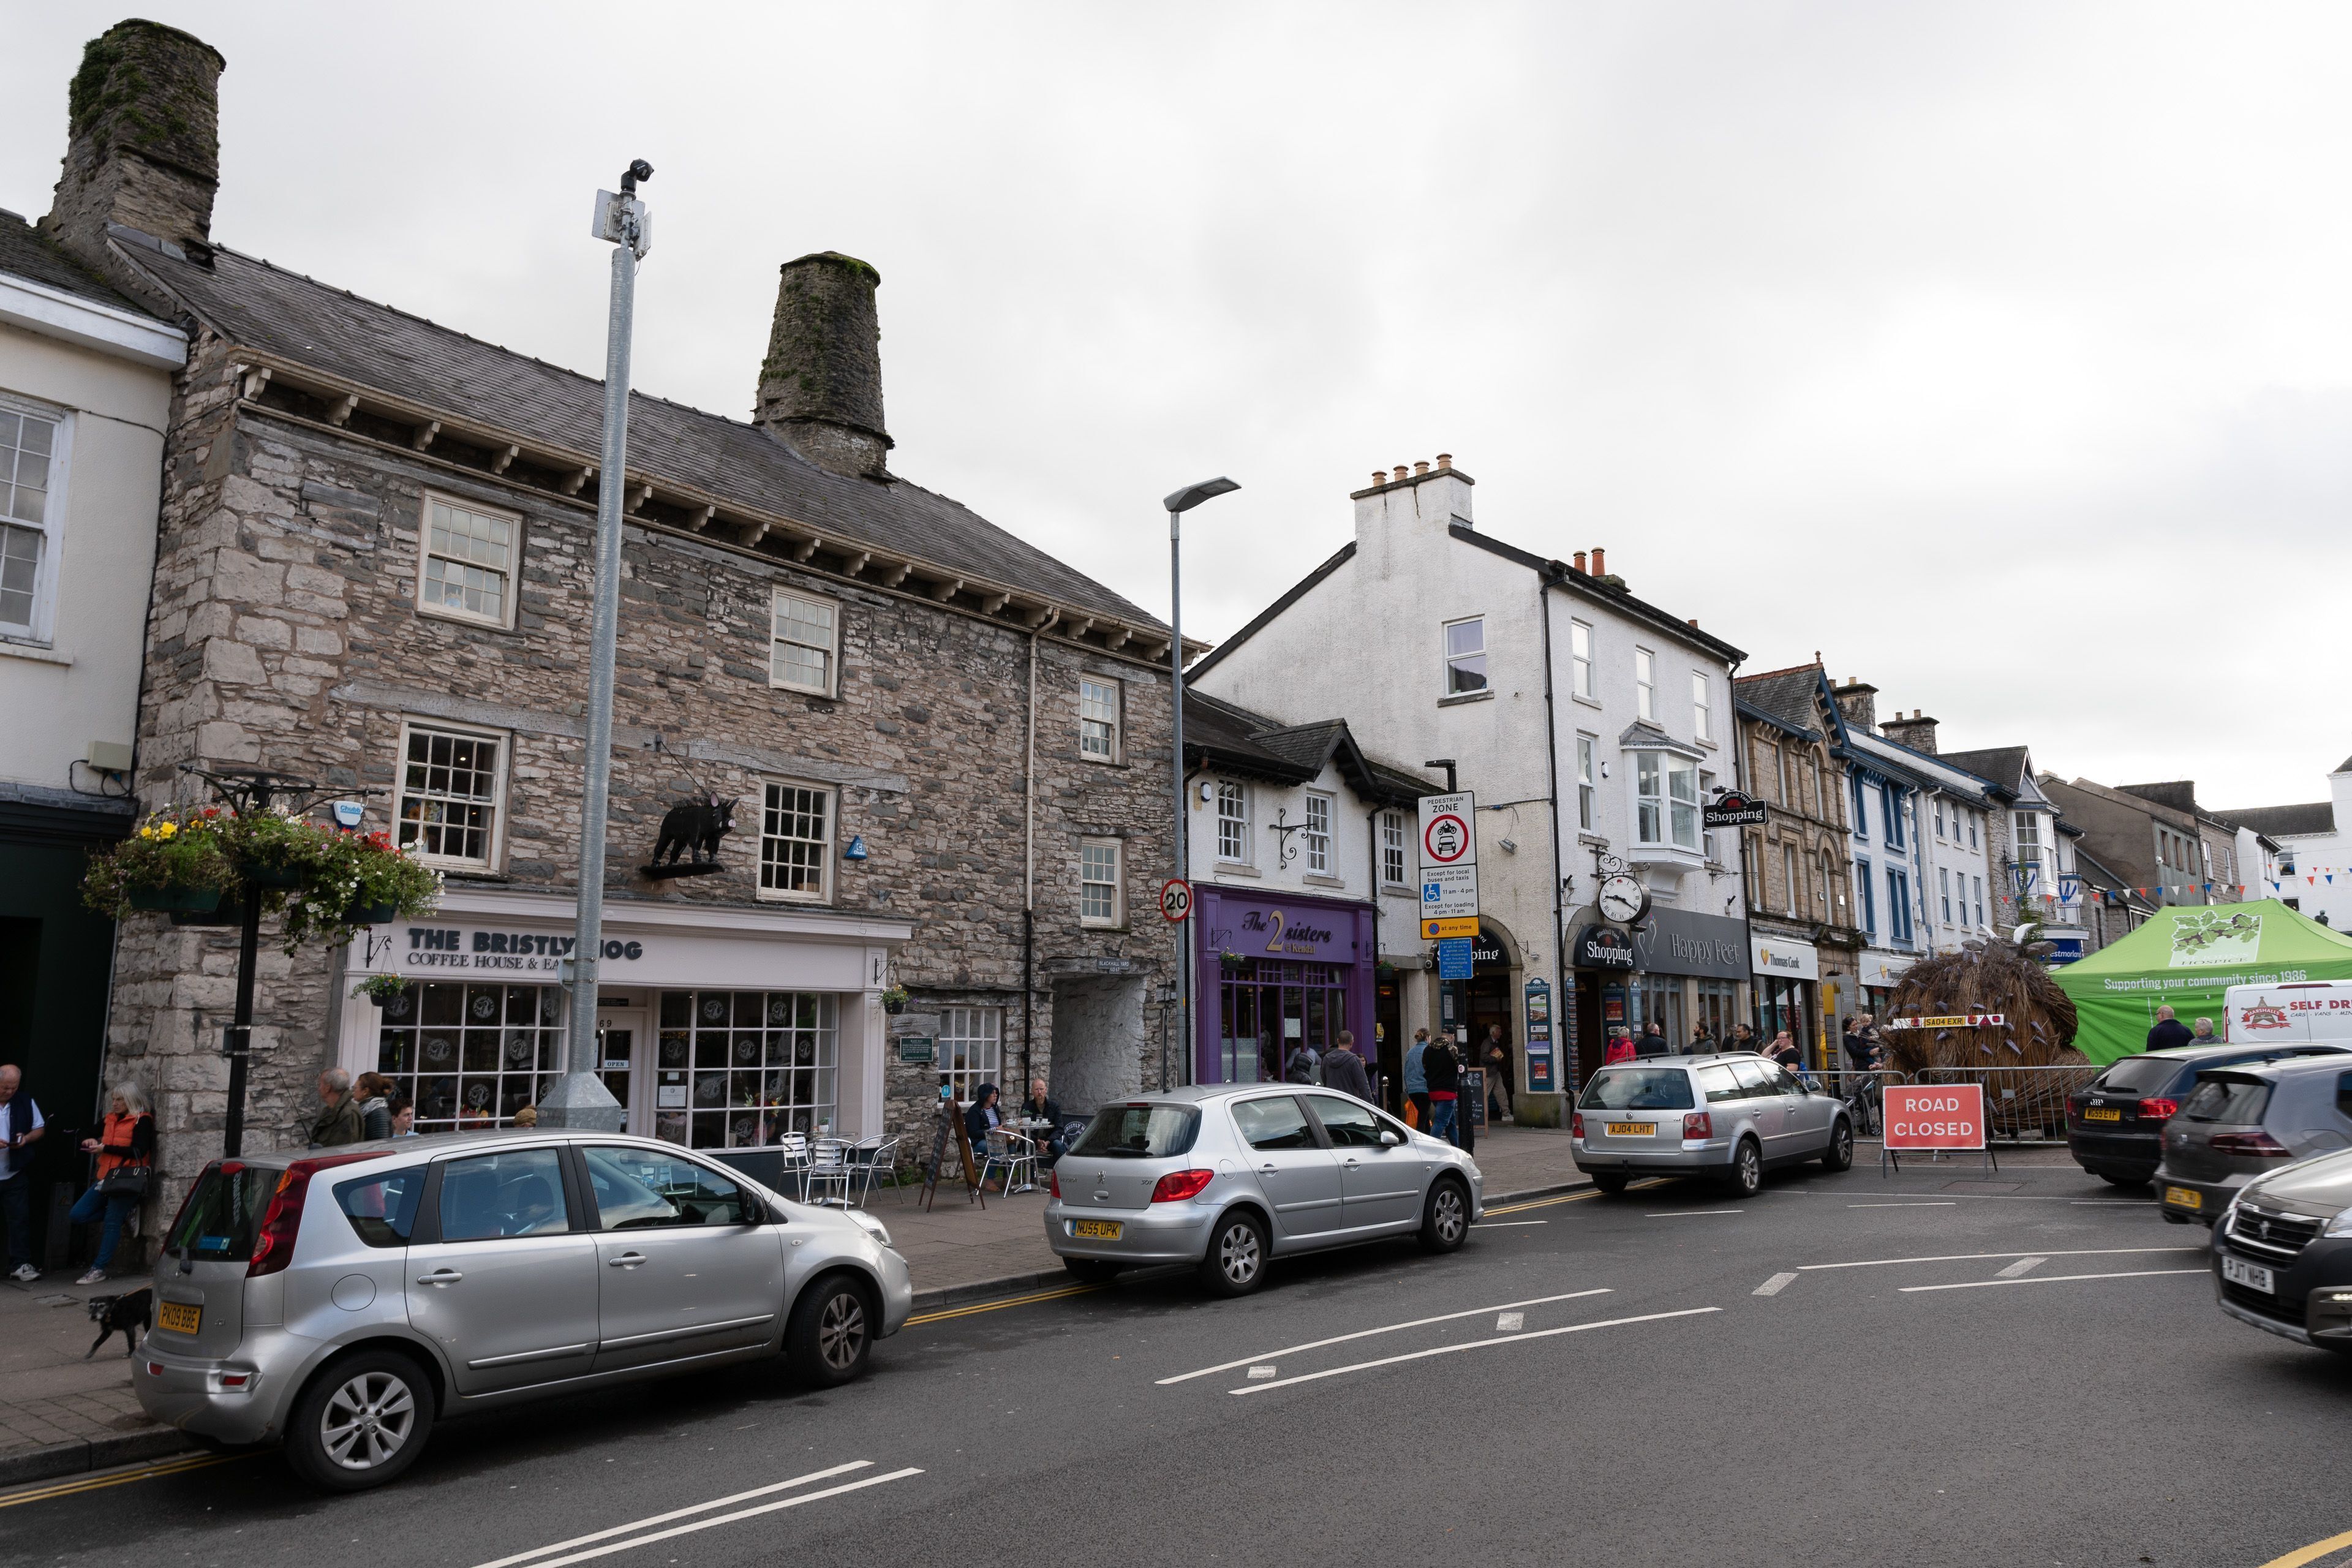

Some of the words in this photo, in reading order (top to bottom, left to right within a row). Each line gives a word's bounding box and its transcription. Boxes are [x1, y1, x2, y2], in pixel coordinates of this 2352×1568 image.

[1427, 796, 1464, 805] PEDESTRIAN
[1717, 793, 1740, 806] Blackhall
[1740, 794, 1751, 804] Yard
[1433, 803, 1458, 813] ZONE
[1706, 810, 1763, 823] Shopping
[1166, 892, 1188, 910] 20
[1242, 911, 1268, 932] The
[1266, 910, 1284, 951] 2
[1284, 922, 1333, 943] sisters
[409, 928, 461, 951] THE
[473, 932, 575, 956] BRISTLY
[600, 940, 643, 960] OG
[1292, 943, 1315, 954] Kendal
[1672, 934, 1712, 965] Happy
[1715, 939, 1740, 965] Feet
[408, 952, 469, 966] COFFEE
[475, 955, 524, 970] HOUSE
[529, 959, 538, 970] &
[1587, 941, 1633, 966] Shopping
[1770, 953, 1788, 968] Thomas
[1789, 956, 1800, 968] Cook
[2105, 978, 2162, 991] Supporting
[2163, 978, 2186, 989] your
[2188, 974, 2246, 987] community
[2250, 973, 2277, 984] since
[2279, 970, 2307, 982] 1986
[2290, 1001, 2323, 1011] SELF
[2329, 1000, 2352, 1009] DR
[1905, 1098, 1959, 1112] ROAD
[2105, 1109, 2117, 1118] ETF
[1894, 1122, 1973, 1136] CLOSED
[1077, 1221, 1098, 1235] NU55
[1100, 1223, 1117, 1236] UPK
[161, 1306, 181, 1327] PK09
[182, 1308, 197, 1329] BBE
